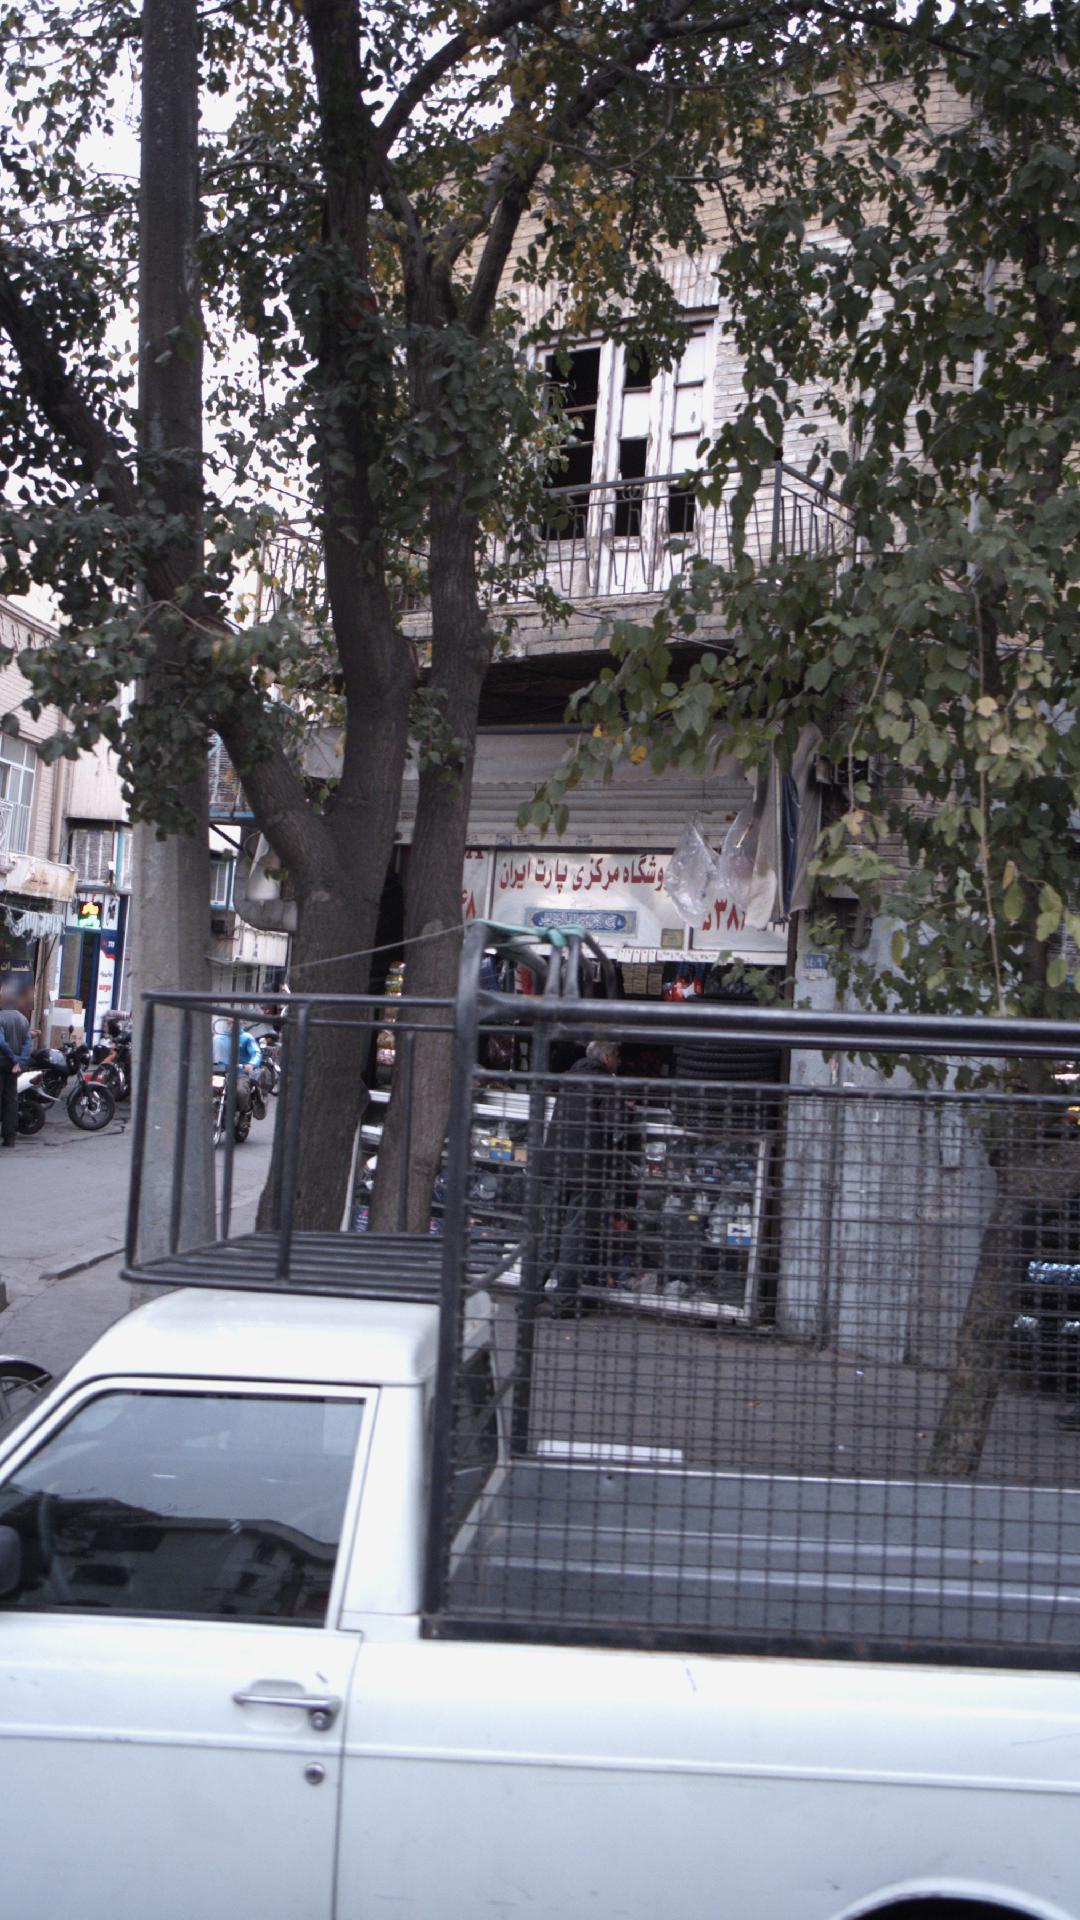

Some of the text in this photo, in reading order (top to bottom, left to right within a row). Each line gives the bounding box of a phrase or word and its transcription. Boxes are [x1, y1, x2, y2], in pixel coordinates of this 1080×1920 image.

[499, 855, 532, 890] ایران
[534, 857, 568, 895] پارت
[572, 857, 620, 892] مرکزی
